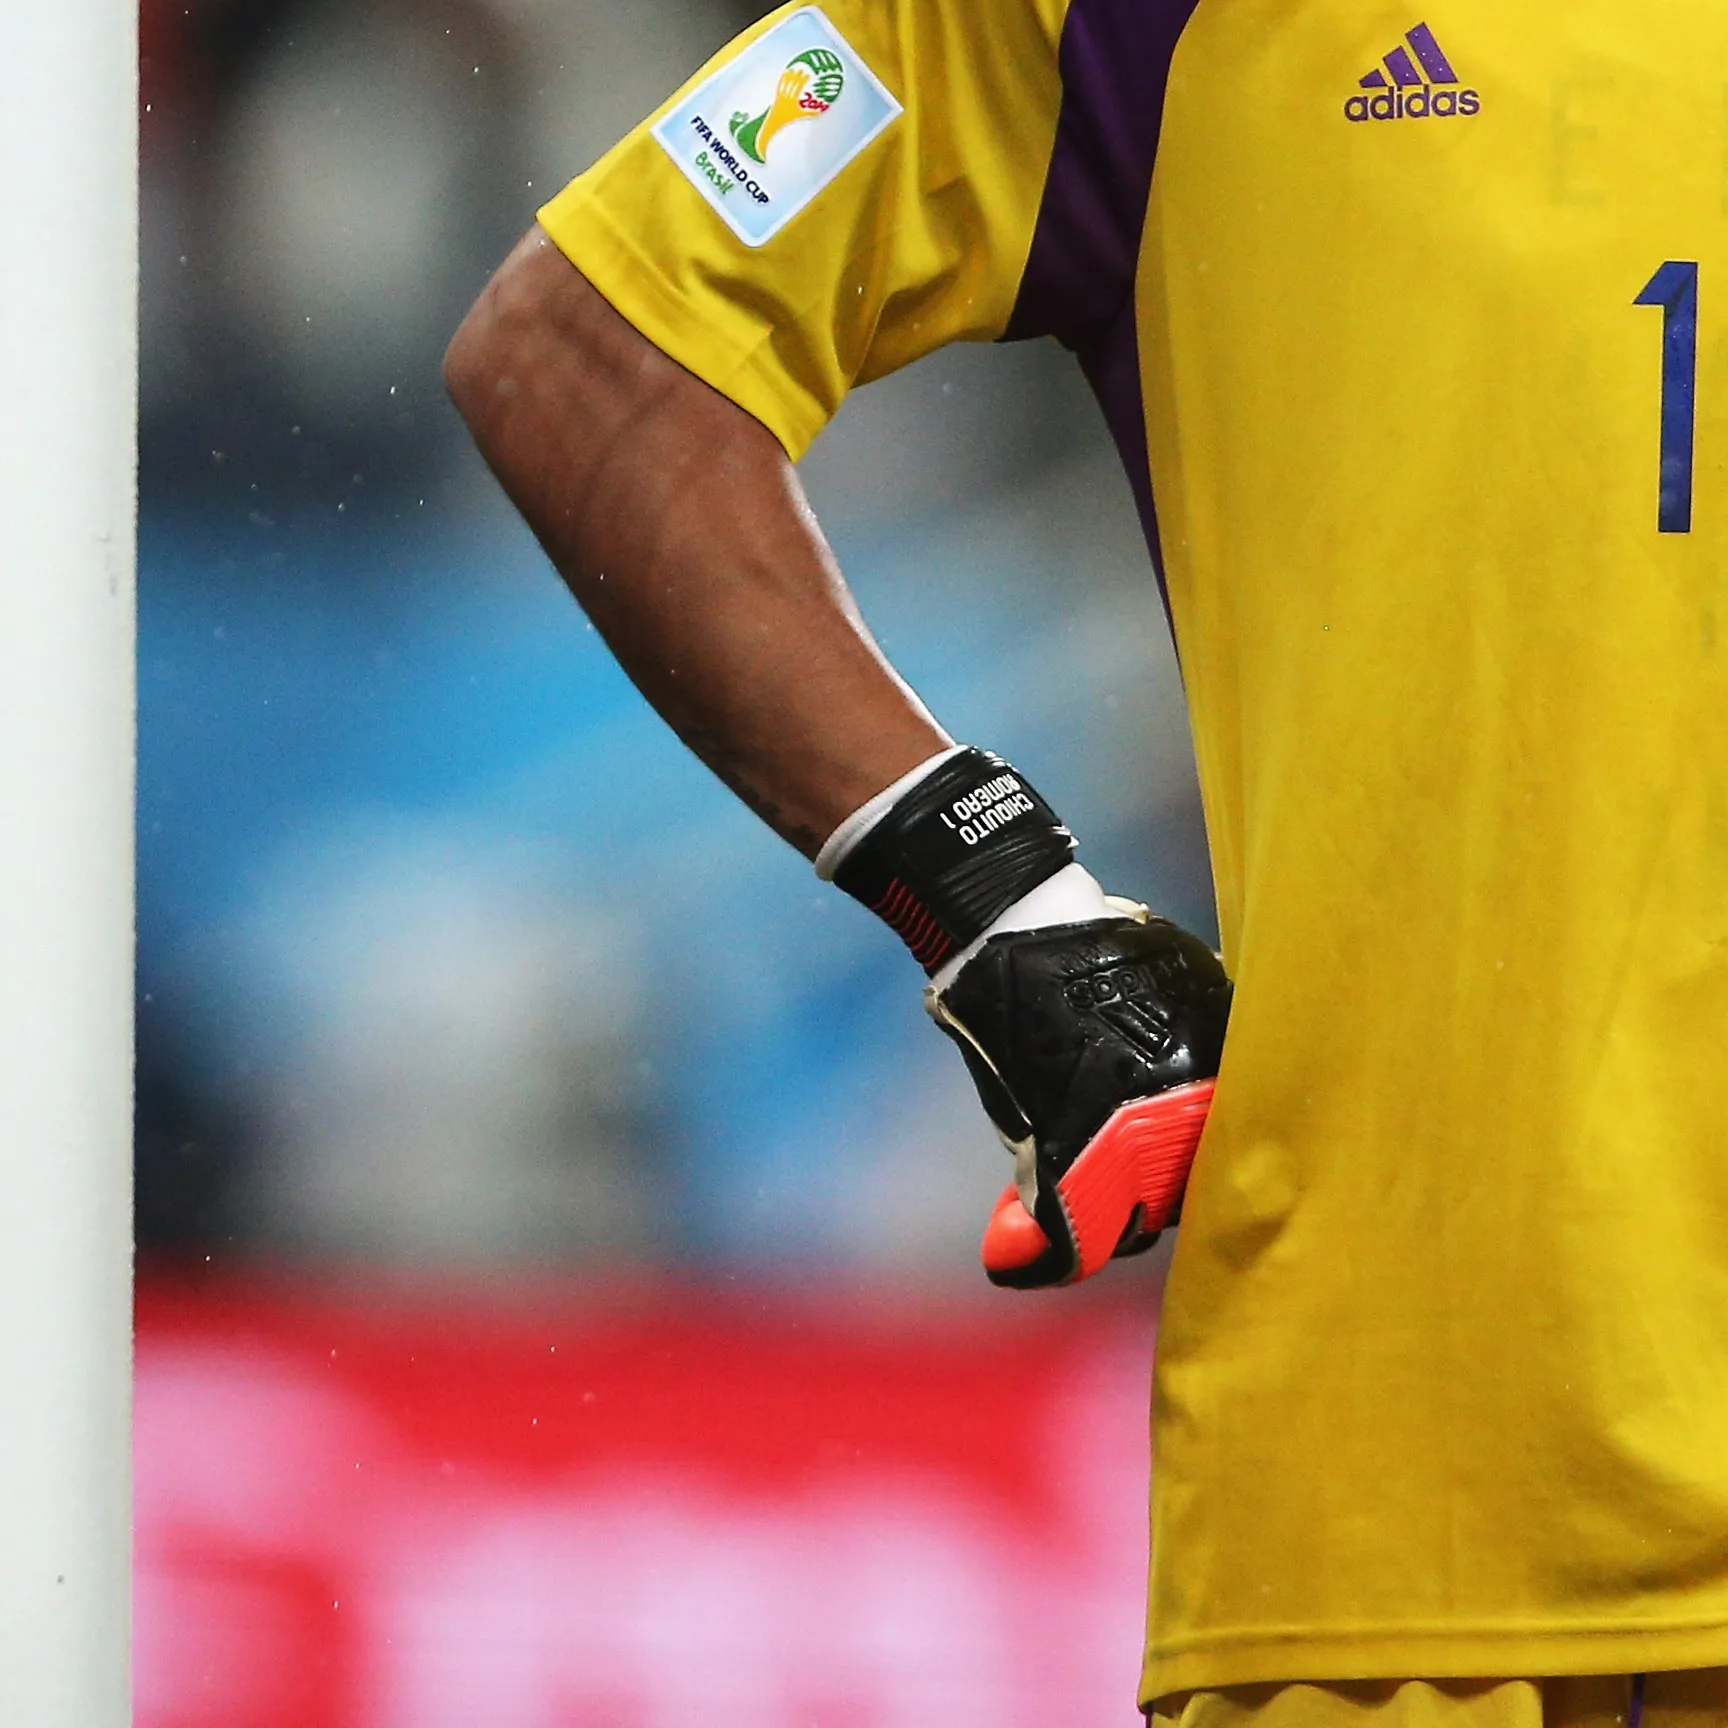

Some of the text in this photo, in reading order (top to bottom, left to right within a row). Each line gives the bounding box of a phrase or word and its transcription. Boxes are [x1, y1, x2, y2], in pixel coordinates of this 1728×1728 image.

[1343, 83, 1480, 122] adidas
[690, 115, 769, 204] FIFA WORLD CUP
[1631, 260, 1699, 533] 1
[939, 773, 1022, 829] ROMERO 1
[959, 793, 1035, 845] CHIQUITO
